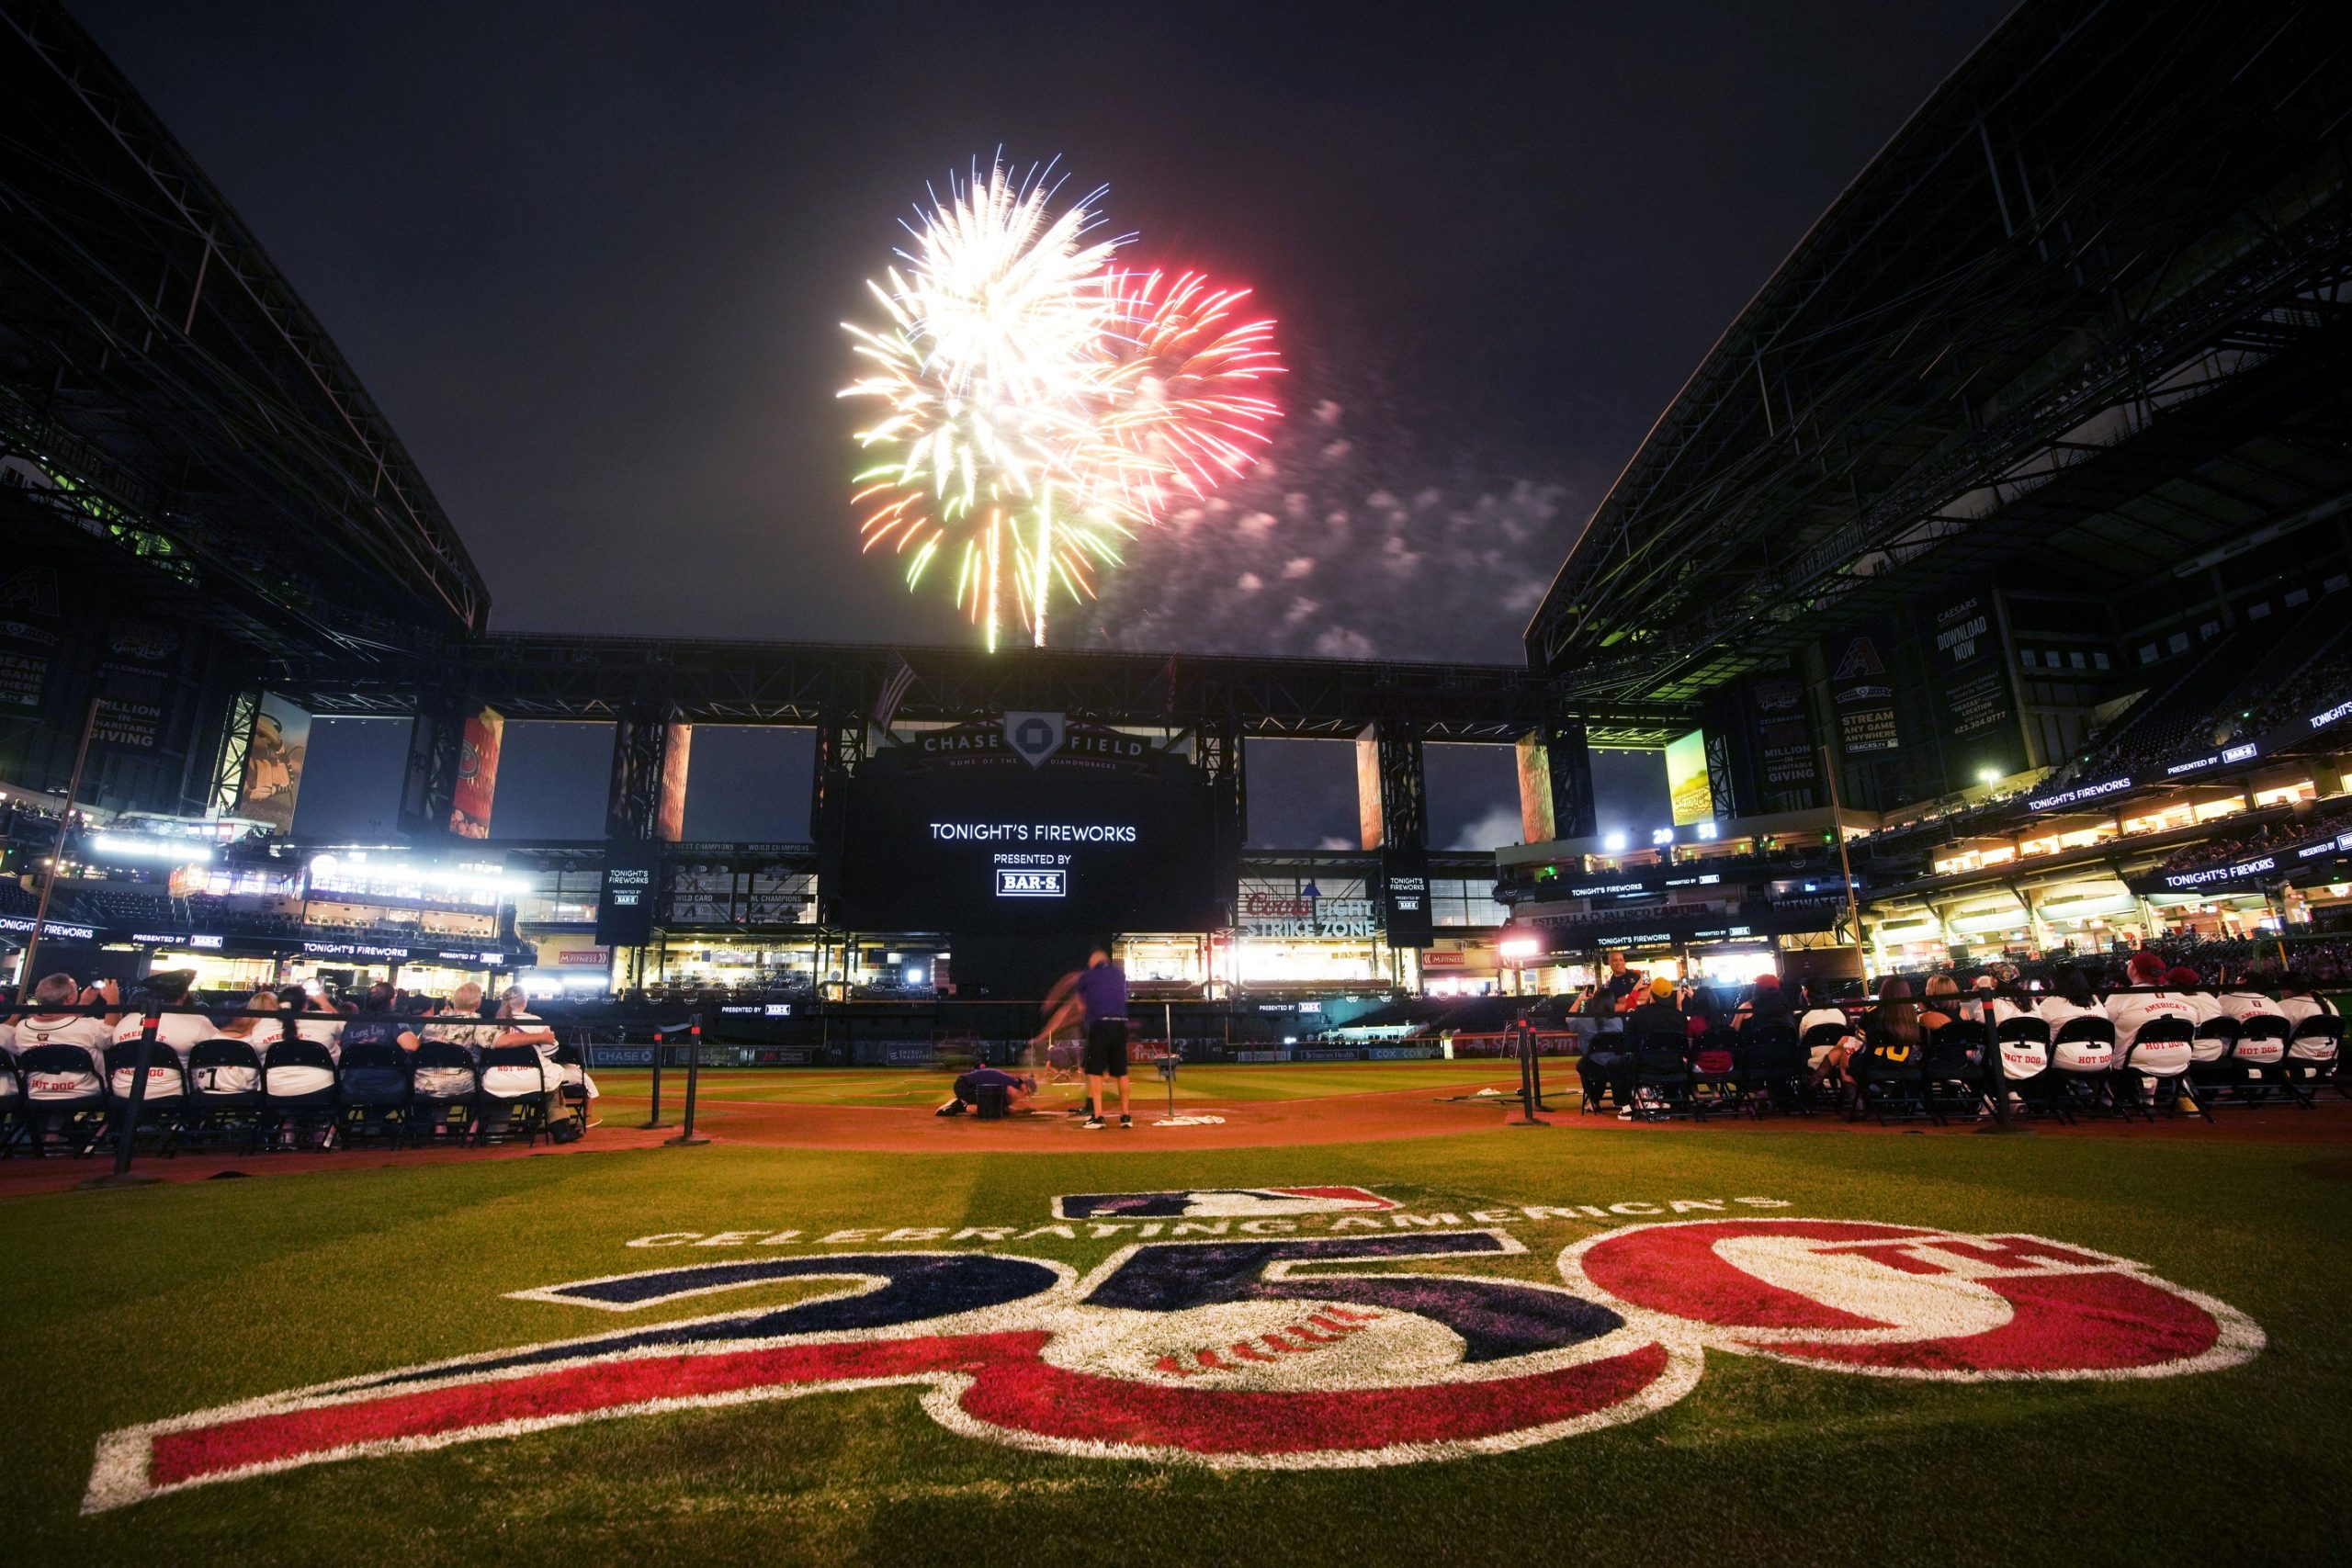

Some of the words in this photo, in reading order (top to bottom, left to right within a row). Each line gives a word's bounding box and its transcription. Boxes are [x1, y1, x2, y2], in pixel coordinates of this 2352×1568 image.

[1937, 597, 1977, 623] CAESARS
[1937, 615, 1986, 650] DOWNLOAD
[1953, 638, 1974, 661] NOW
[1842, 712, 1894, 726] STREAM
[96, 720, 156, 735] HARITABLE
[1844, 726, 1865, 735] ANY
[1867, 722, 1896, 732] GAME
[1846, 730, 1896, 742] ANYWHERE
[924, 734, 999, 751] CHASE
[1071, 736, 1143, 756] FIELD
[1764, 745, 1812, 758] MILLION
[1050, 759, 1117, 770] DIAMONDBACKS
[2167, 761, 2207, 774] PRESENTED
[2208, 757, 2218, 765] BY
[1769, 769, 1815, 783] GIVING
[2029, 792, 2075, 810] TONIGHT'S
[2077, 777, 2132, 799] FIREWORKS
[930, 823, 1028, 840] TONIGHT'S
[1035, 825, 1136, 841] FIREWORKS
[1652, 828, 1673, 844] 20
[695, 843, 734, 852] CHAMPIONS
[772, 844, 809, 852] CHAMPIONS
[2299, 844, 2327, 858] PRESENTED
[993, 854, 1055, 864] PRESENTED
[1057, 854, 1071, 865] BY
[610, 869, 649, 877] TONIGHT'S
[2165, 868, 2227, 887] TONIGHT'S
[2230, 858, 2274, 877] FIREWORKS
[609, 876, 649, 885] FIREWORKS
[1572, 886, 1605, 897] TONIGHT'S
[1607, 884, 1643, 893] FIREWORKS
[761, 895, 802, 903] CHAMPIONS
[1245, 891, 1310, 917] Coors
[1603, 908, 1651, 921] JALISCO
[0, 919, 42, 932] ONIGHT
[44, 924, 93, 939] FIREWORKS
[1247, 920, 1316, 937] STRIKE
[1321, 920, 1376, 937] ZONE
[133, 934, 174, 943] PRESENTED
[1598, 937, 1632, 945] TONIGHT'S
[1634, 933, 1670, 943] FIREWORKS
[304, 942, 354, 954] TONIGHT'S
[356, 945, 407, 957] FIREWORKS
[439, 952, 469, 960] PRESENTED
[2144, 1002, 2187, 1013] AMERICA'S
[119, 1031, 165, 1041] AMER'S
[2145, 1041, 2165, 1050] HOT
[598, 1051, 639, 1061] CHASE
[2005, 1053, 2022, 1063] HOT
[2025, 1055, 2041, 1064] DOG
[2078, 1055, 2096, 1064] HOT
[51, 1081, 74, 1090] DOG
[626, 1220, 1297, 1247] CELEBRATING
[1329, 1195, 1793, 1229] AMERICA'S
